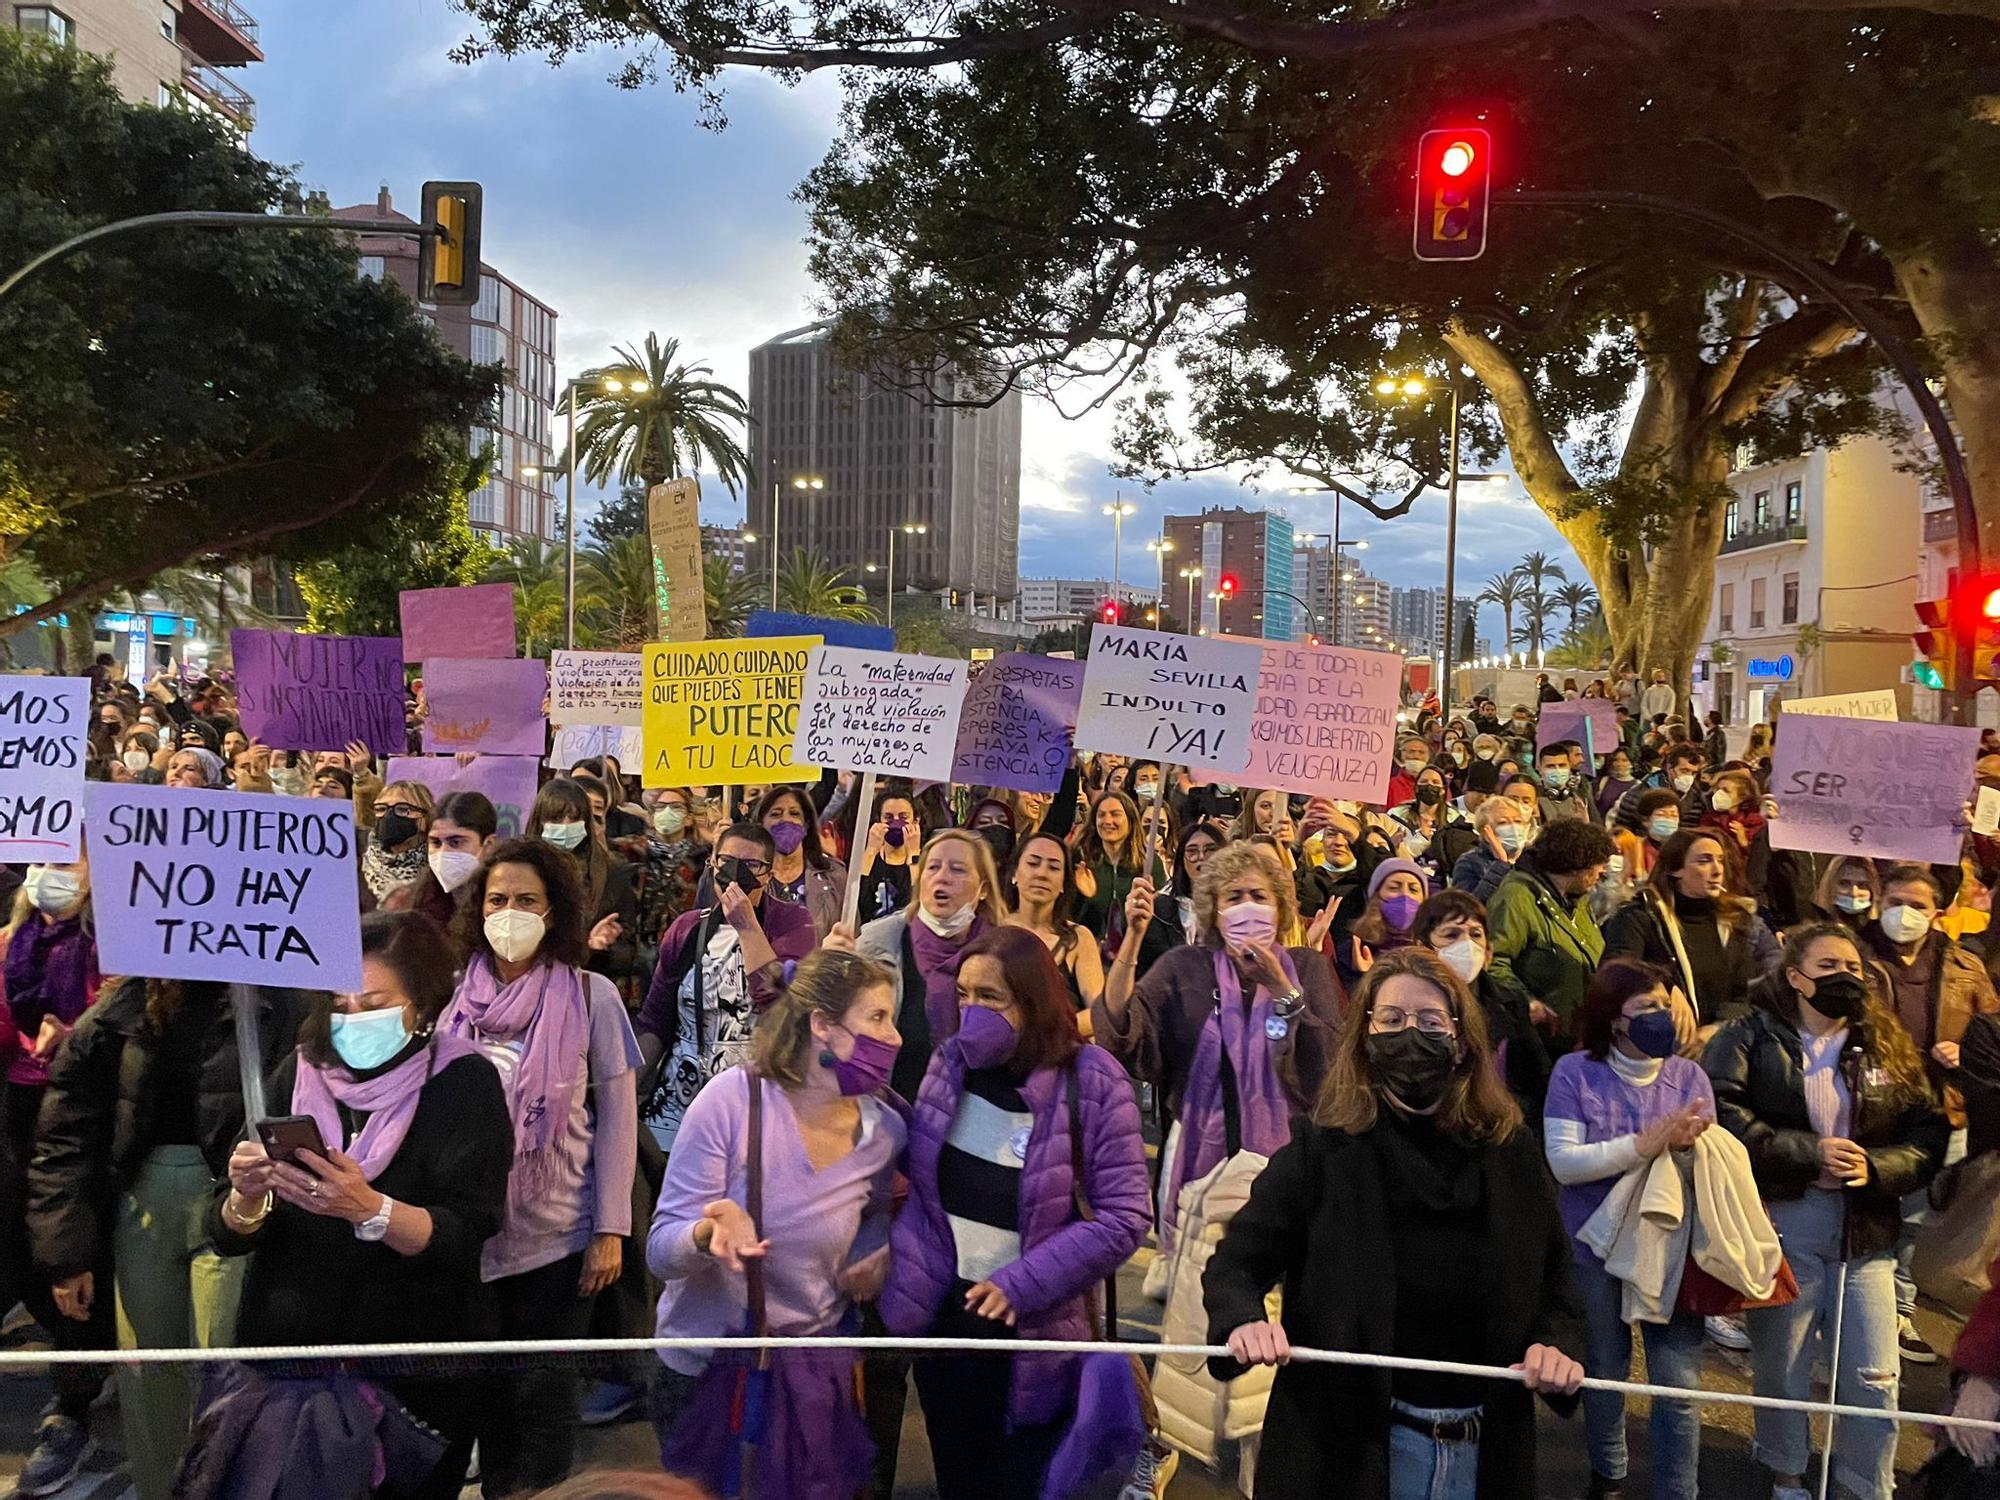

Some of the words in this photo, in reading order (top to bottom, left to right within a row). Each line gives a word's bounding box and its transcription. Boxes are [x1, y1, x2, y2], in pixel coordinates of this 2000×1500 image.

[555, 653, 573, 667] La
[1099, 635, 1188, 662] MARÍA
[733, 650, 808, 675] CUIDADO
[818, 650, 847, 677] La
[1285, 650, 1305, 670] DE
[1309, 653, 1358, 676] TODA
[1363, 660, 1383, 678] LA
[609, 676, 622, 687] de
[652, 683, 679, 704] QUE
[683, 678, 743, 702] PUEDES
[1150, 669, 1249, 693] SEVILLA
[1308, 676, 1328, 695] DE
[1338, 680, 1364, 698] LA
[558, 700, 575, 709] de
[813, 702, 831, 714] es
[842, 701, 876, 716] una
[883, 698, 947, 718] violación
[1100, 692, 1226, 716] INDULTO
[809, 712, 833, 730] del
[842, 715, 905, 733] derecho
[911, 718, 931, 734] de
[807, 730, 834, 747] las
[841, 733, 909, 755] mujeres
[913, 741, 928, 755] a
[975, 737, 1031, 756] HAYA
[1306, 725, 1384, 754] LIBERTAD
[655, 749, 671, 770] A
[683, 745, 715, 770] TU
[851, 749, 914, 769] salud
[1266, 749, 1378, 787] VENGANZA
[1784, 770, 1848, 798] SER
[103, 804, 169, 847] SIN
[181, 806, 350, 860] PUTEROS
[128, 860, 216, 909] NO
[235, 866, 313, 915] HAY
[154, 918, 321, 967] TRATA
